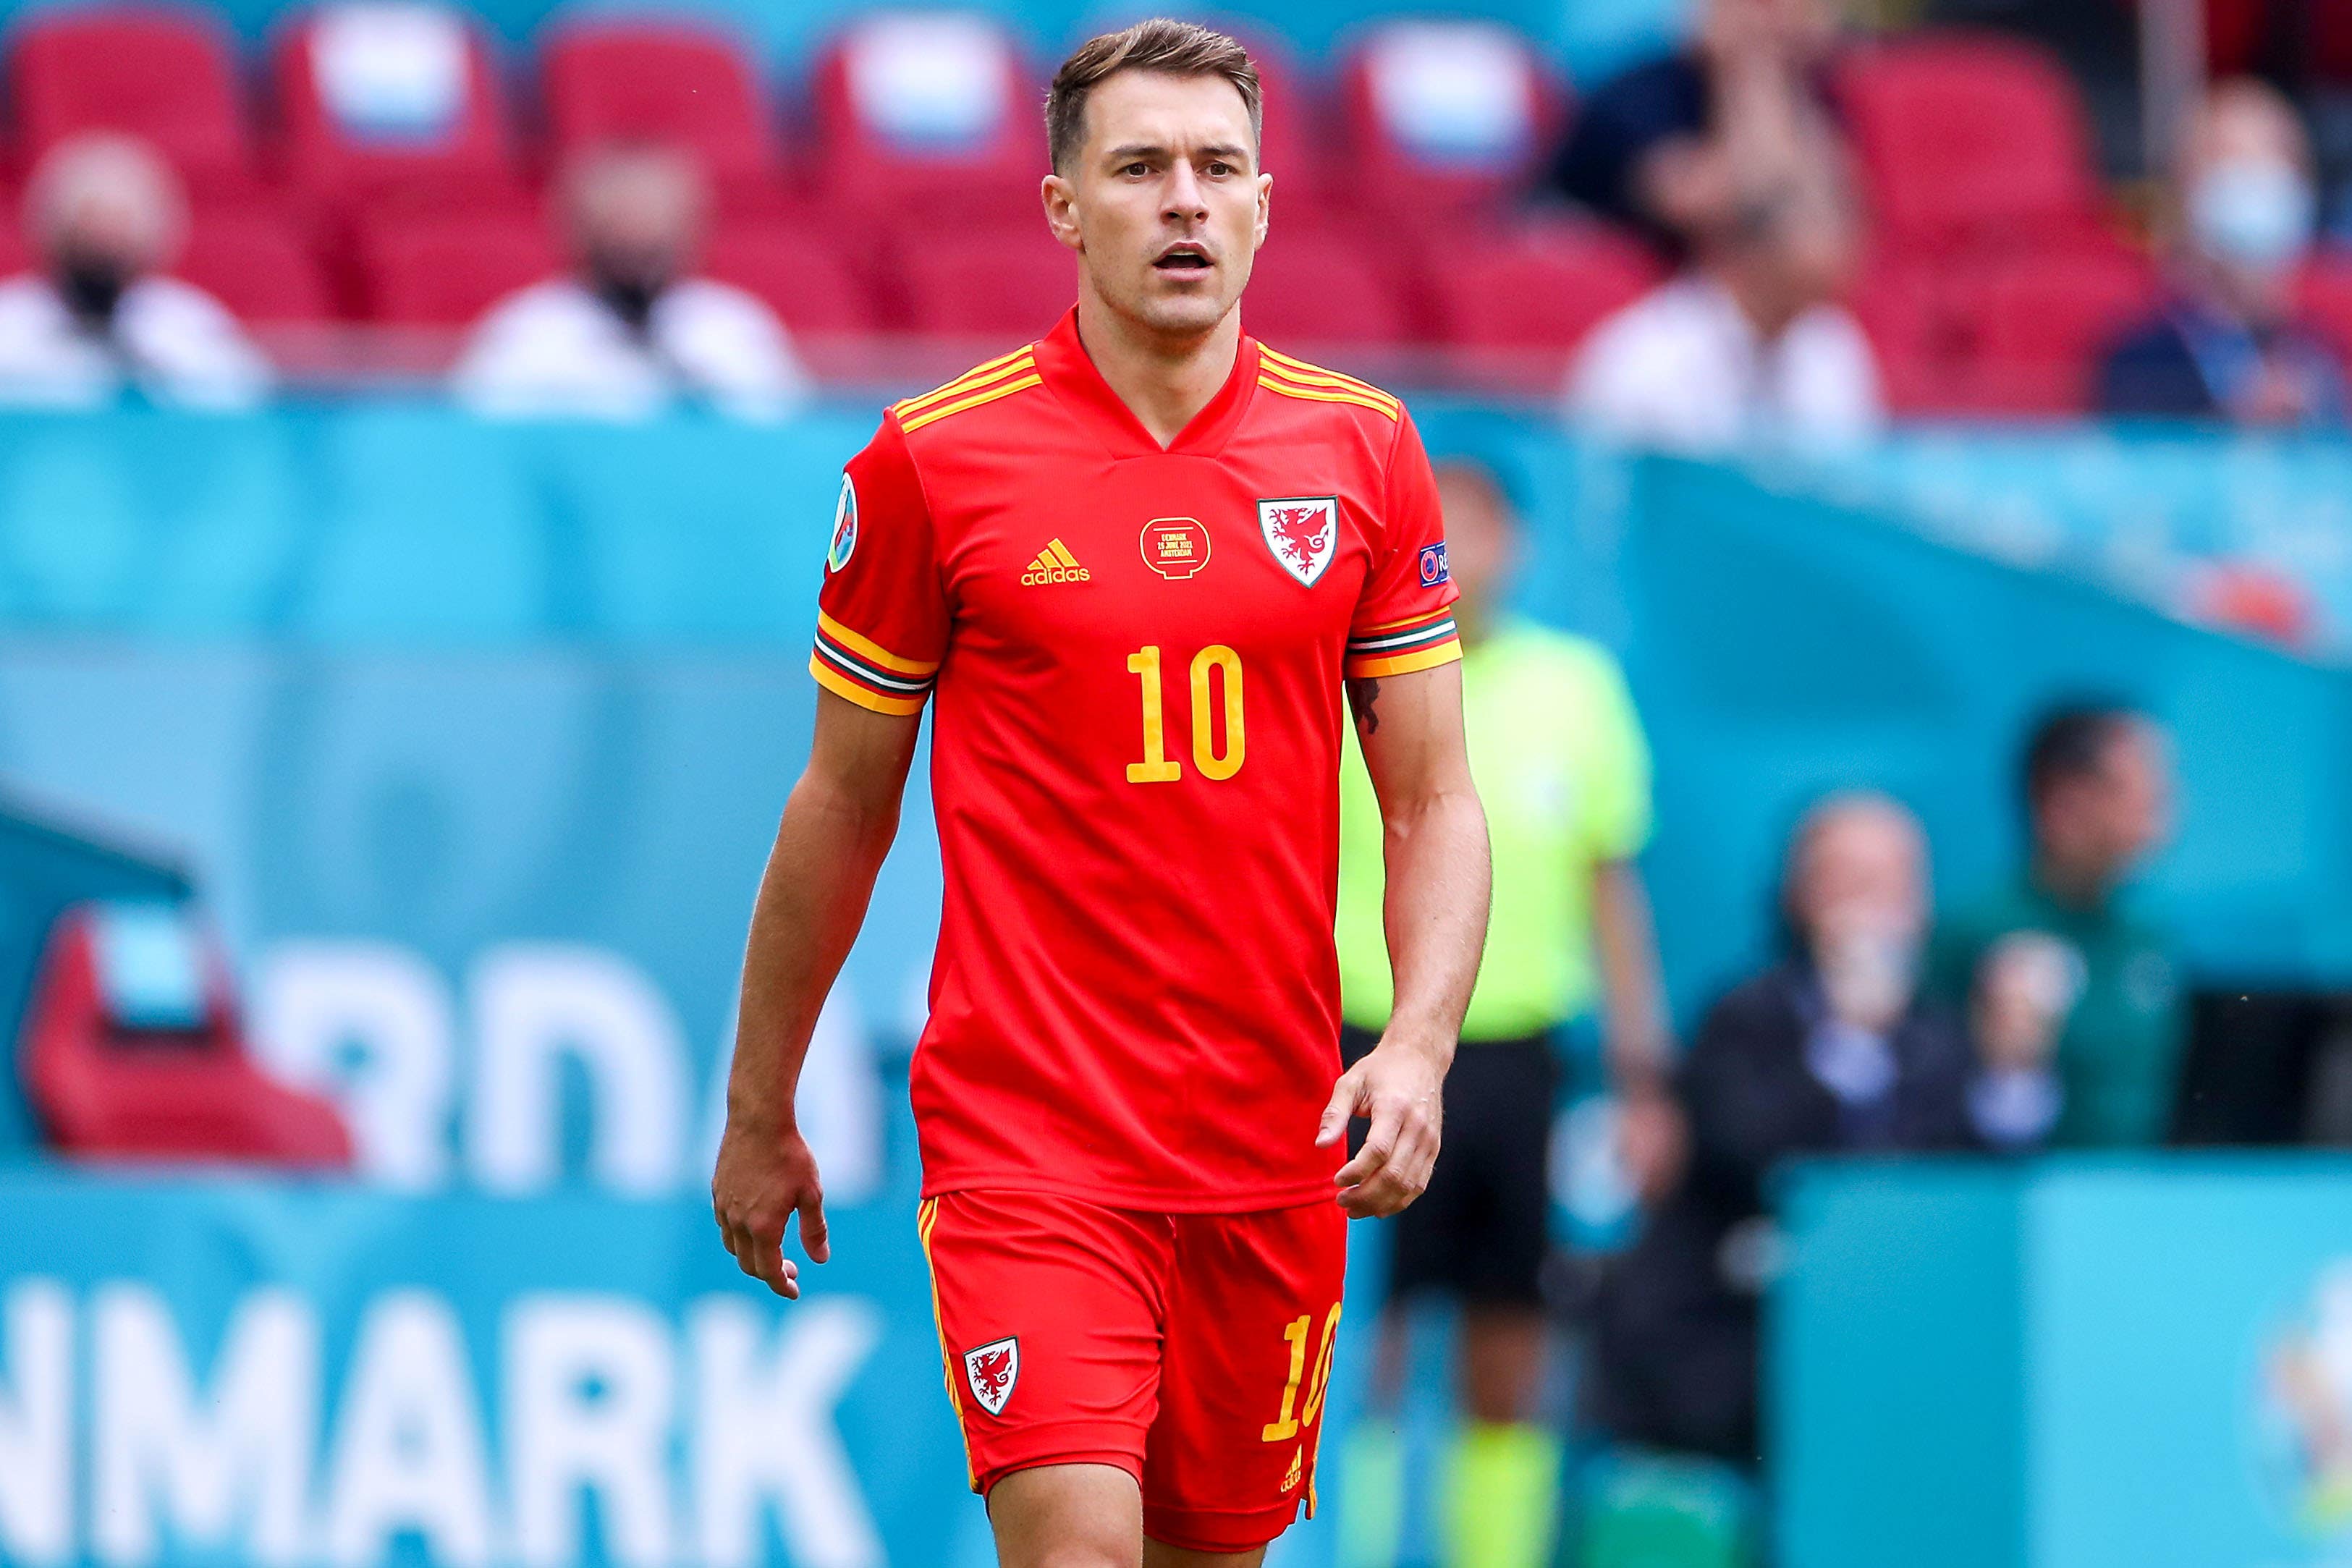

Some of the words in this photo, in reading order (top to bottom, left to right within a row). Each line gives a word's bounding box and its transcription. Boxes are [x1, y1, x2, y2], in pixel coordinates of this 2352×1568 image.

[1020, 567, 1091, 586] adidas
[1126, 644, 1245, 784] 10
[1261, 1301, 1342, 1443] 10
